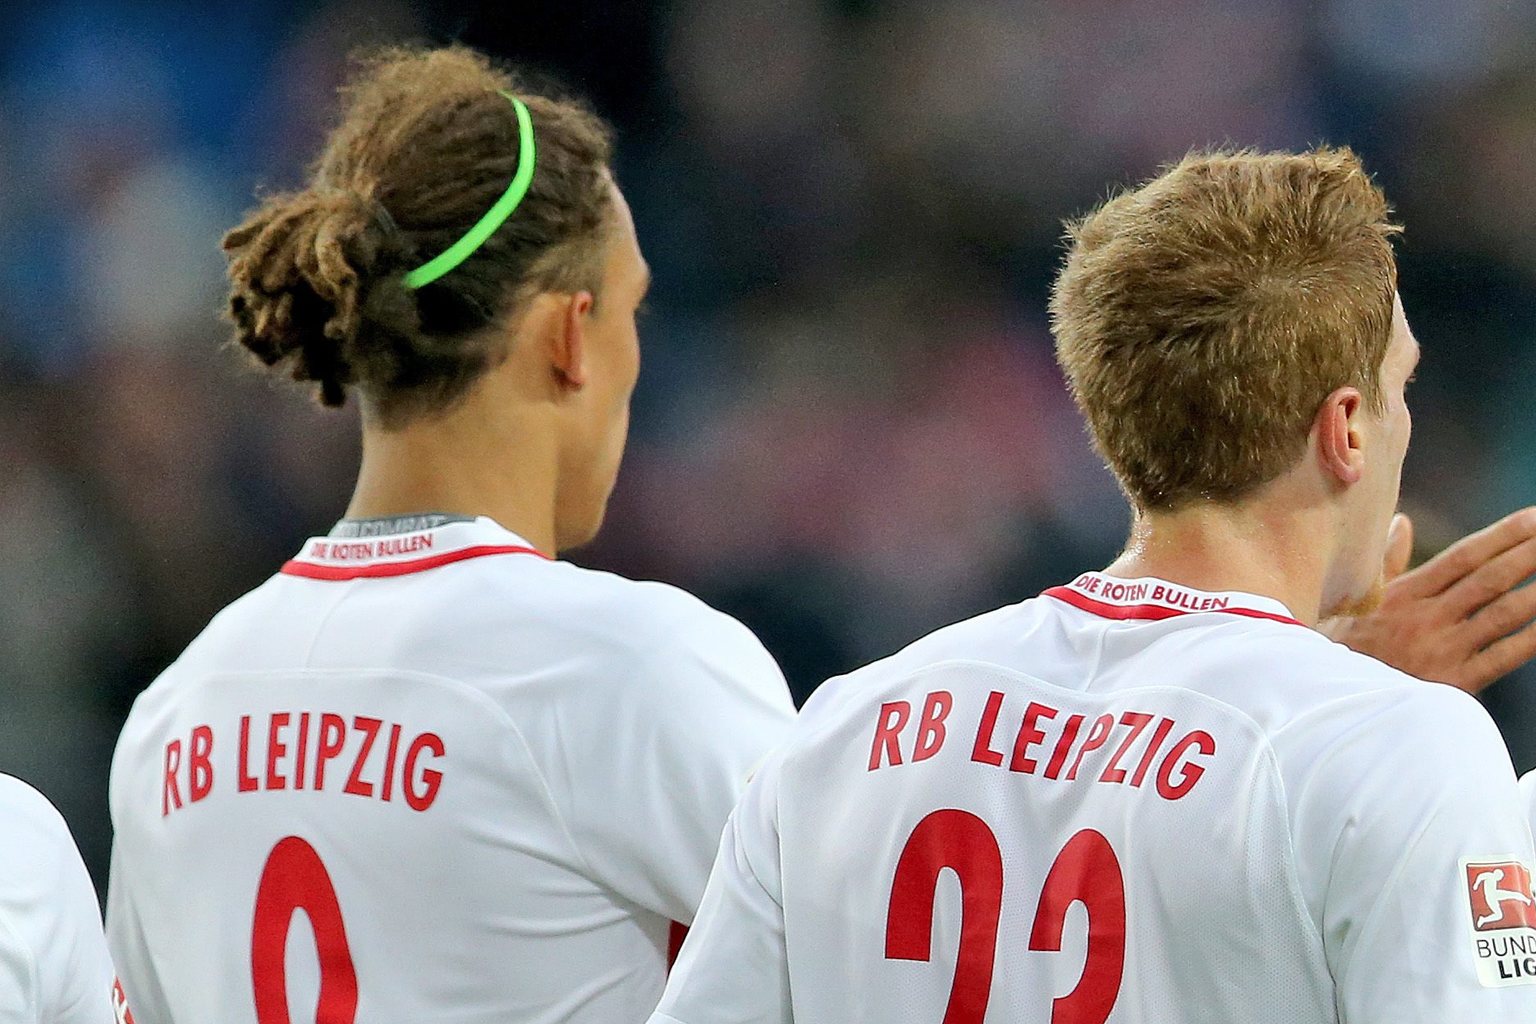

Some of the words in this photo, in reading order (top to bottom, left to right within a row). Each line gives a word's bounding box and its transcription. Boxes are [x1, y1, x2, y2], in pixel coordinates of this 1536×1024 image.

[377, 534, 433, 557] BULLEN
[1075, 575, 1101, 593] DIE
[1101, 582, 1148, 601] ROTEN
[1152, 586, 1229, 610] BULLEN
[161, 724, 214, 817] RB
[238, 711, 446, 812] LEIPZIG
[868, 690, 953, 772] RB
[970, 690, 1216, 801] LEIPZIG
